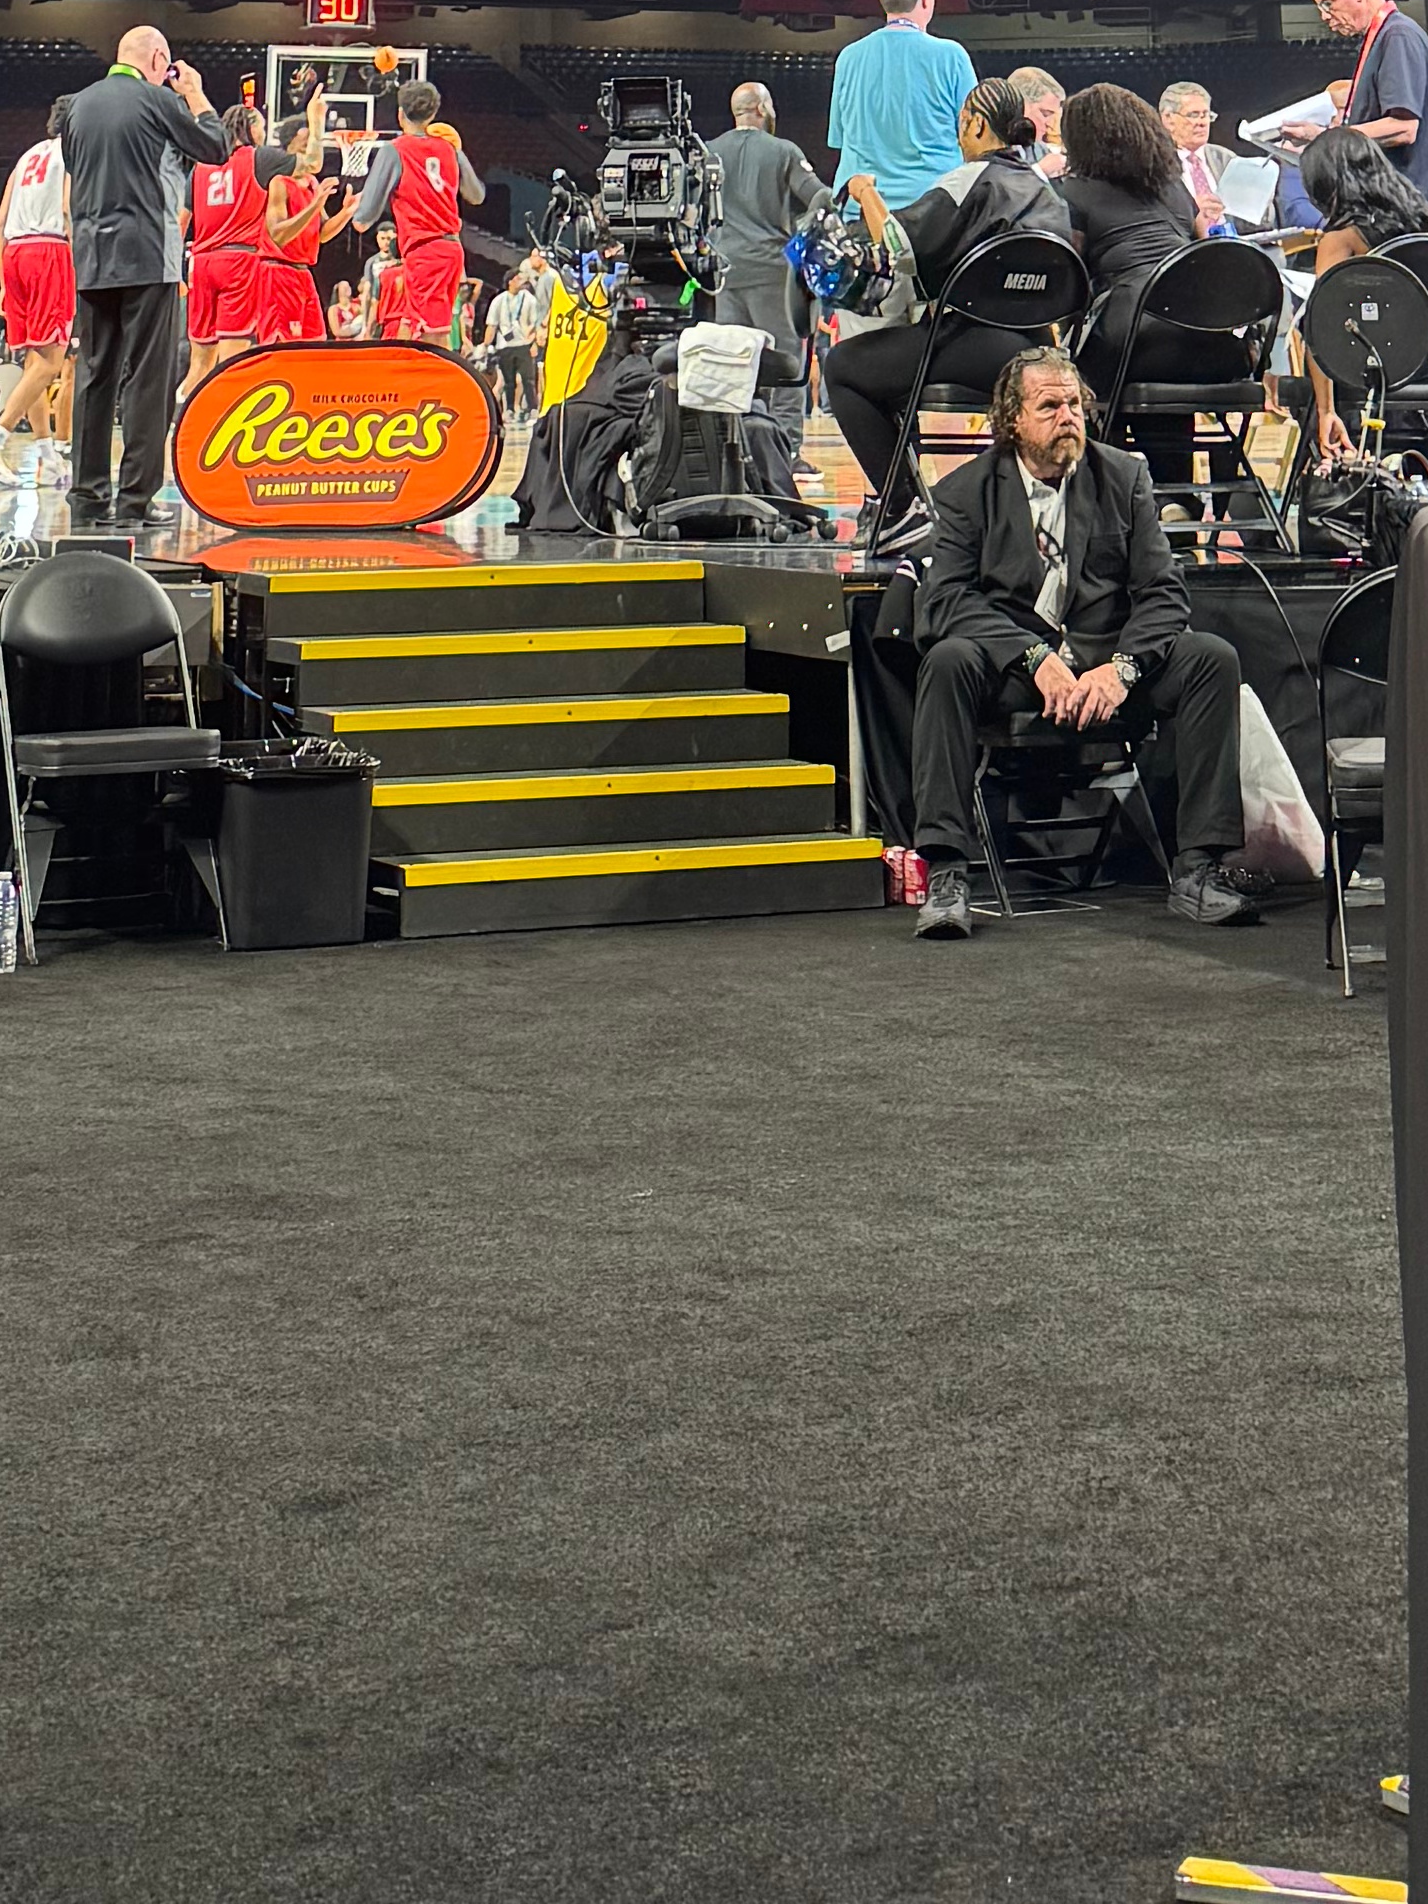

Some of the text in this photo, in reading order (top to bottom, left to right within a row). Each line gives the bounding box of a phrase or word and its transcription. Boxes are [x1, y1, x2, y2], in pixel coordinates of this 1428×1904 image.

[21, 153, 53, 188] 24
[207, 169, 235, 207] 21
[1003, 273, 1047, 290] MEDIA
[341, 393, 399, 403] CHOCOLATE
[204, 383, 453, 467] Reese's
[257, 479, 396, 497] PEANUT BUTTER CUPS
